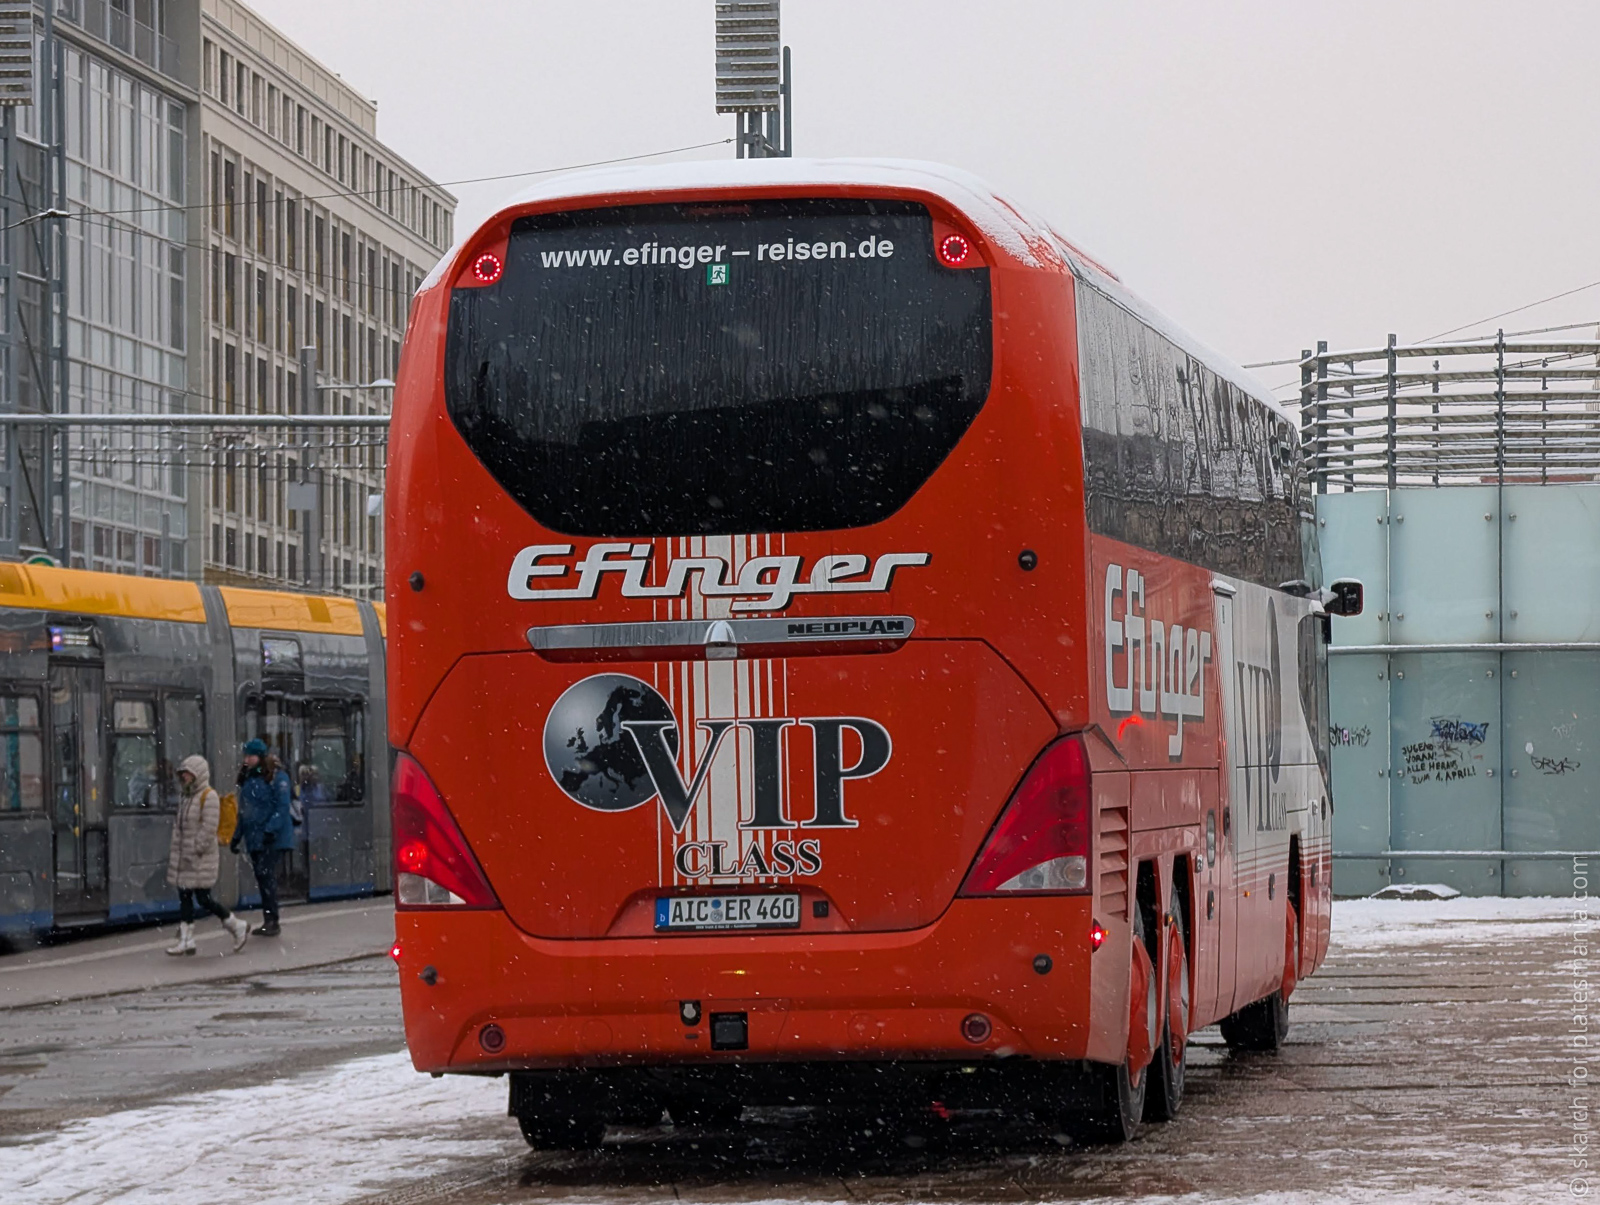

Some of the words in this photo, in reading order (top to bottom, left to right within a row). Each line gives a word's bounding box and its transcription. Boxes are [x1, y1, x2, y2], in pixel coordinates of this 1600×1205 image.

[540, 241, 727, 270] www.efinger
[756, 236, 895, 261] reisen.de
[507, 543, 932, 612] Efinger
[787, 619, 905, 635] NEOPLAN
[1105, 563, 1212, 762] Efinger
[620, 716, 893, 834] VIP
[674, 839, 823, 879] CLASS
[671, 900, 709, 922] AIC
[725, 899, 751, 921] ER
[756, 897, 795, 920] 460
